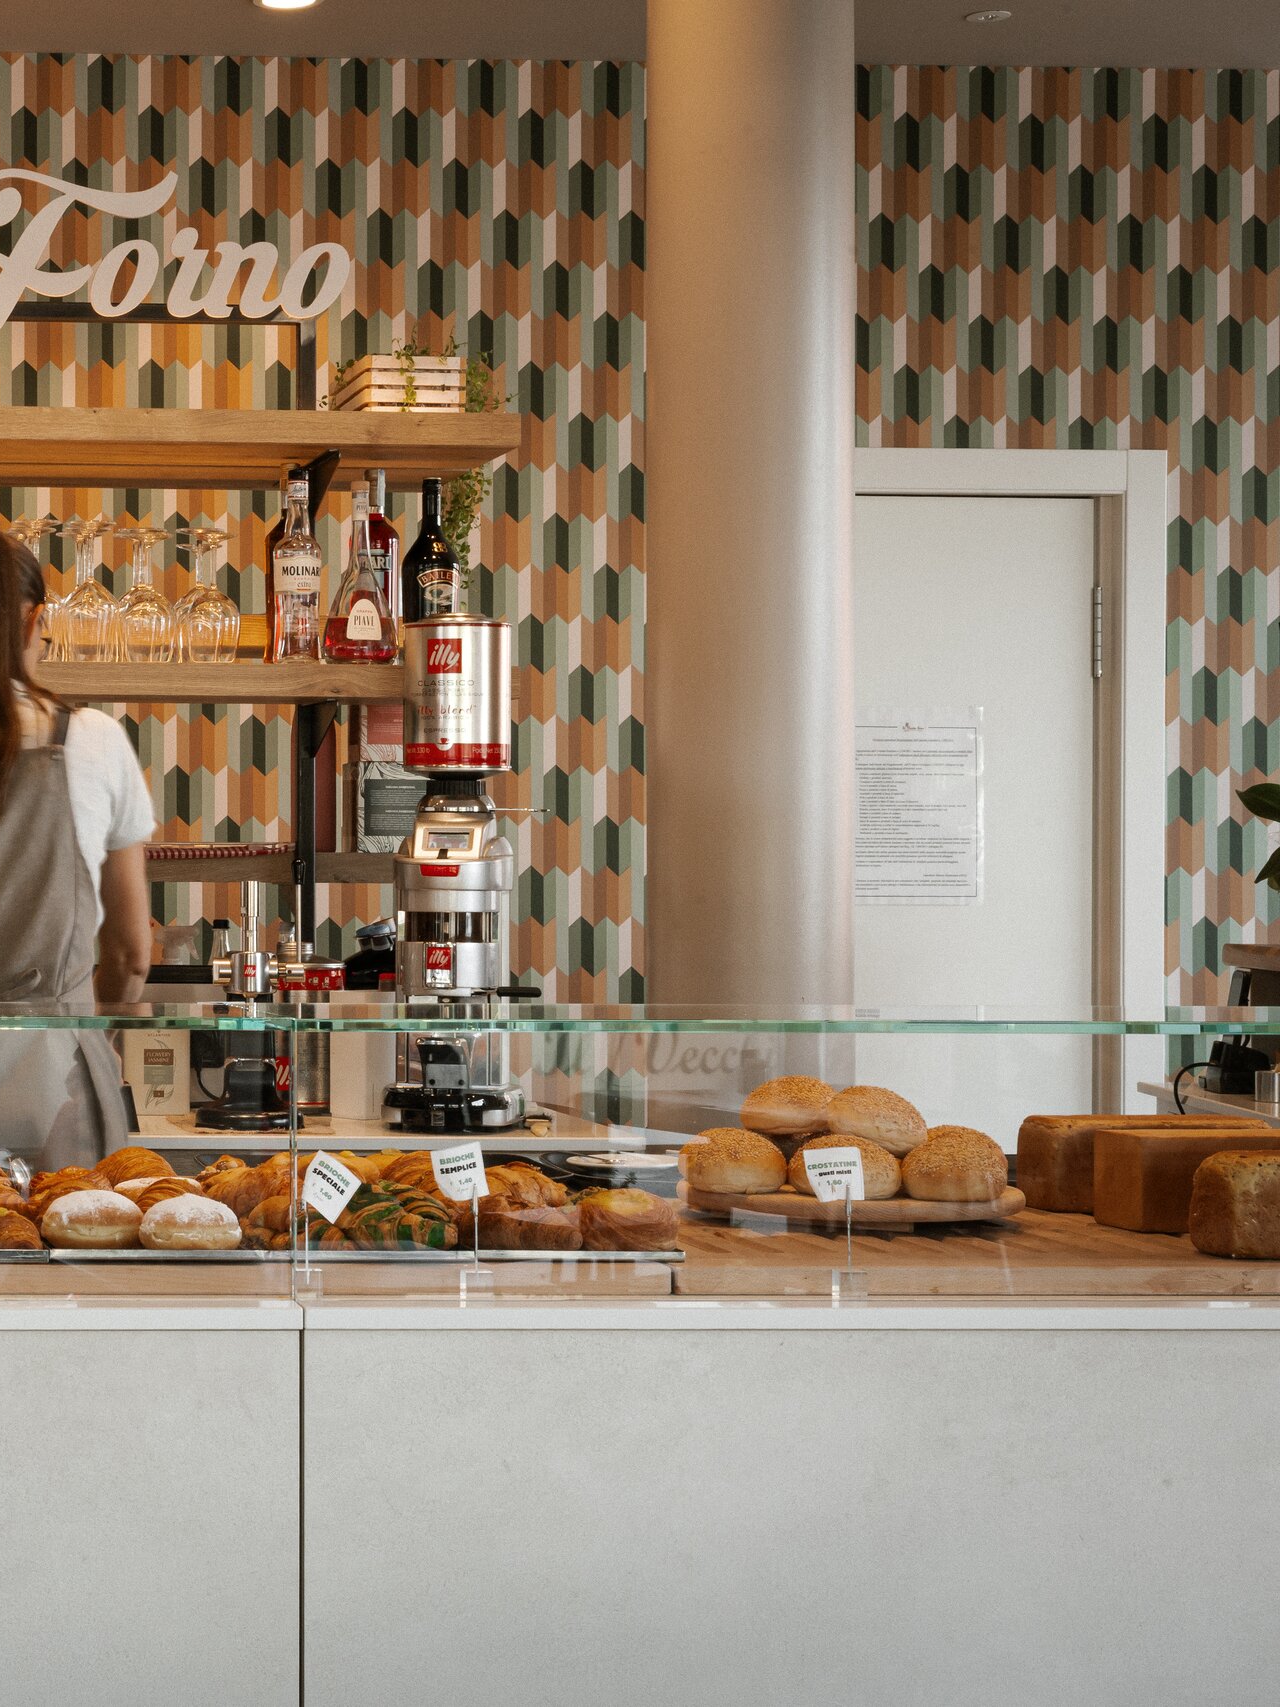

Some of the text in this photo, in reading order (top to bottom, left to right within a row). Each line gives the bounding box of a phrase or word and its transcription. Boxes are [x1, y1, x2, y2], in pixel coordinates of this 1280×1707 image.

[429, 644, 460, 670] illy
[429, 949, 449, 967] illy
[439, 1152, 475, 1165] BRIOCHE
[439, 1162, 477, 1174] SEMPLICE
[312, 1167, 346, 1196] SPECIALE
[318, 1160, 351, 1187] BRIOCHE
